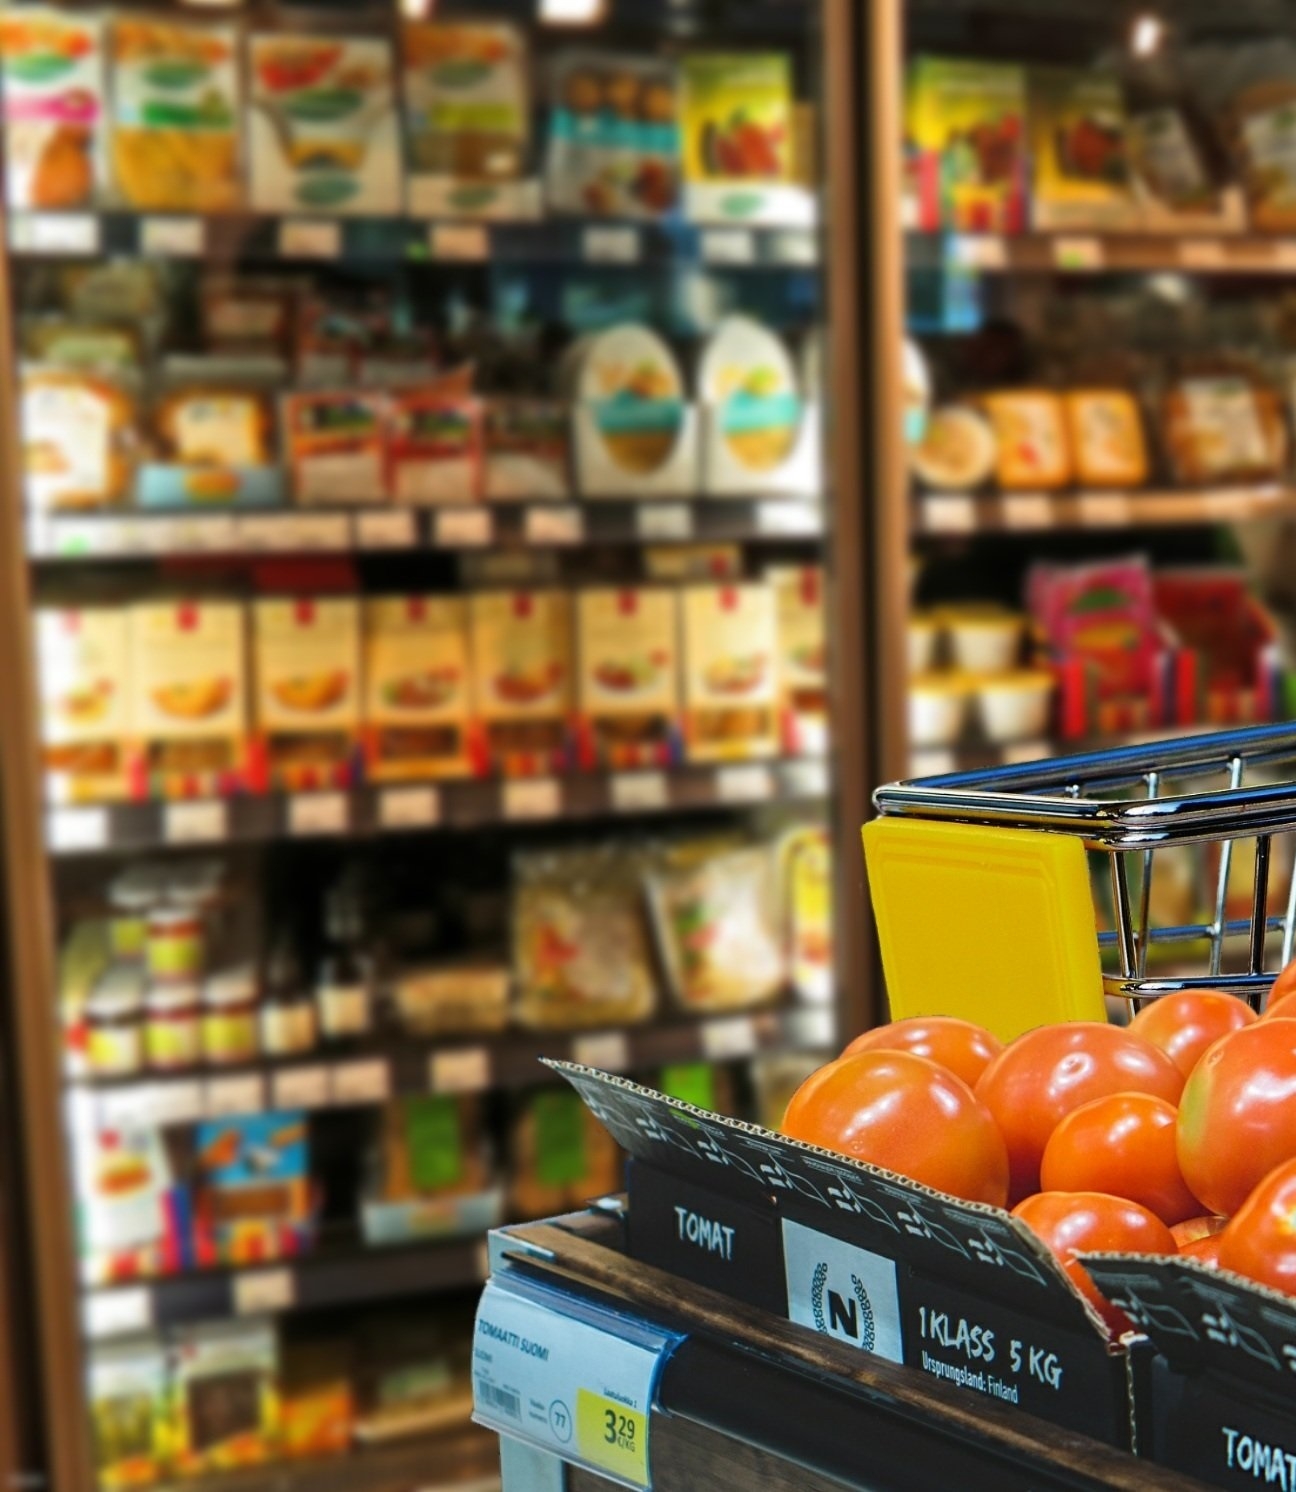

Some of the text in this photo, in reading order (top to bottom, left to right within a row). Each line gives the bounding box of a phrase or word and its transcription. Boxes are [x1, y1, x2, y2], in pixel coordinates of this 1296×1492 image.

[674, 1206, 735, 1261] TOMAT
[828, 1290, 858, 1338] N
[479, 1319, 549, 1362] TOMAATTI SUOMI
[919, 1306, 1063, 1390] 1 KLASS 5 KG
[922, 1350, 1019, 1404] Ursprungsland: Finland
[555, 1411, 566, 1429] 77
